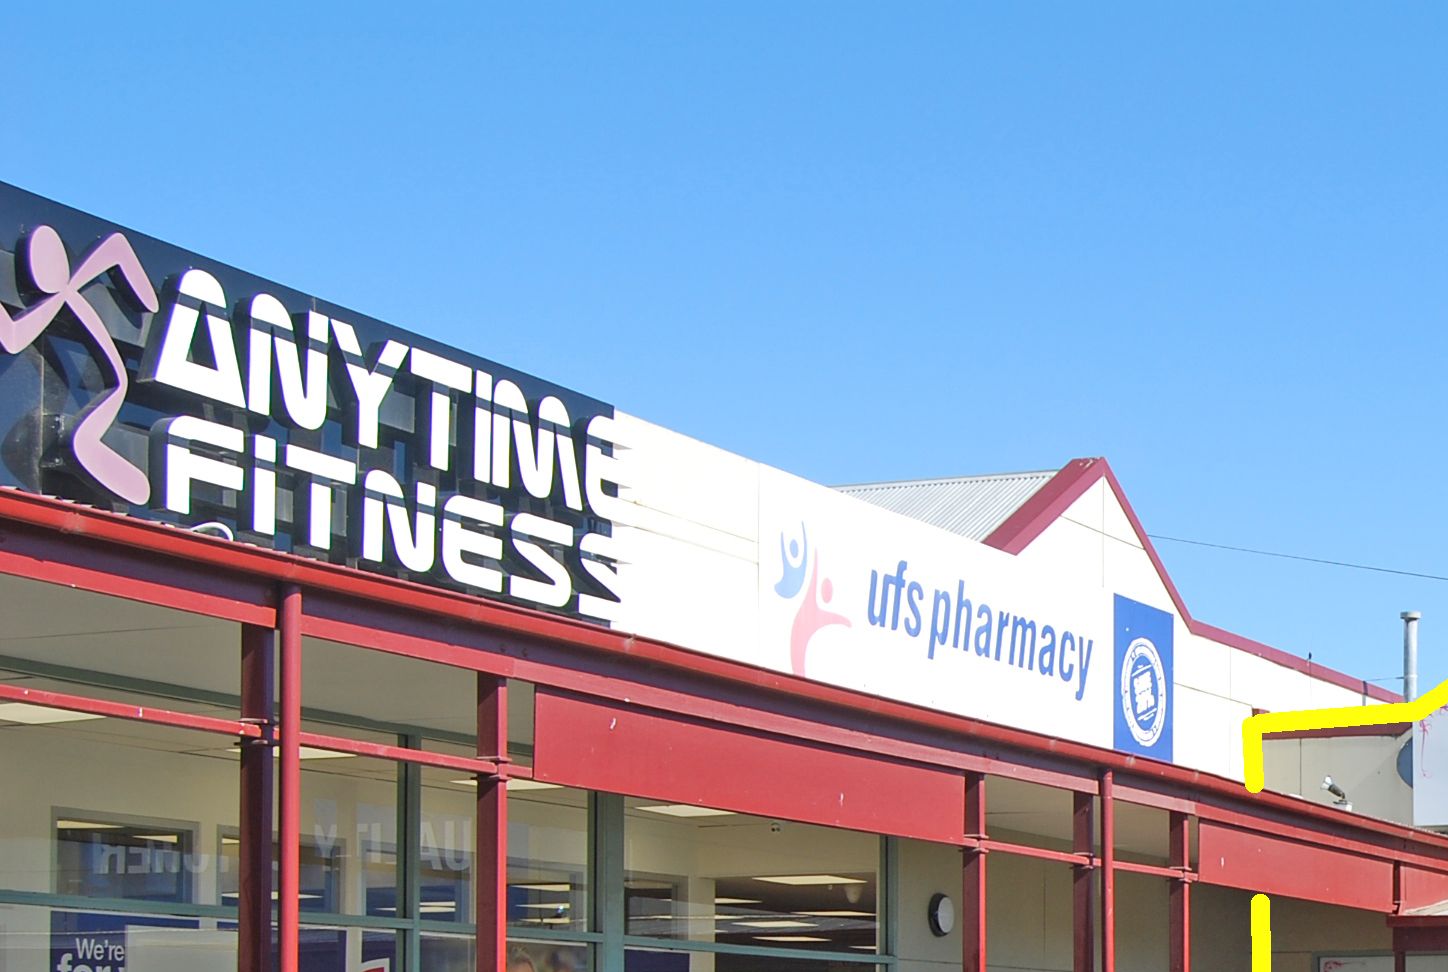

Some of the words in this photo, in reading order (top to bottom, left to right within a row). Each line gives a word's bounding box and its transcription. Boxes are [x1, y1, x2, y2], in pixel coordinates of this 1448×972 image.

[155, 269, 630, 520] ANYTIME
[165, 415, 622, 618] FITNESS
[868, 560, 923, 637] ufs
[928, 580, 1093, 701] pharmacy
[75, 937, 125, 962] We're
